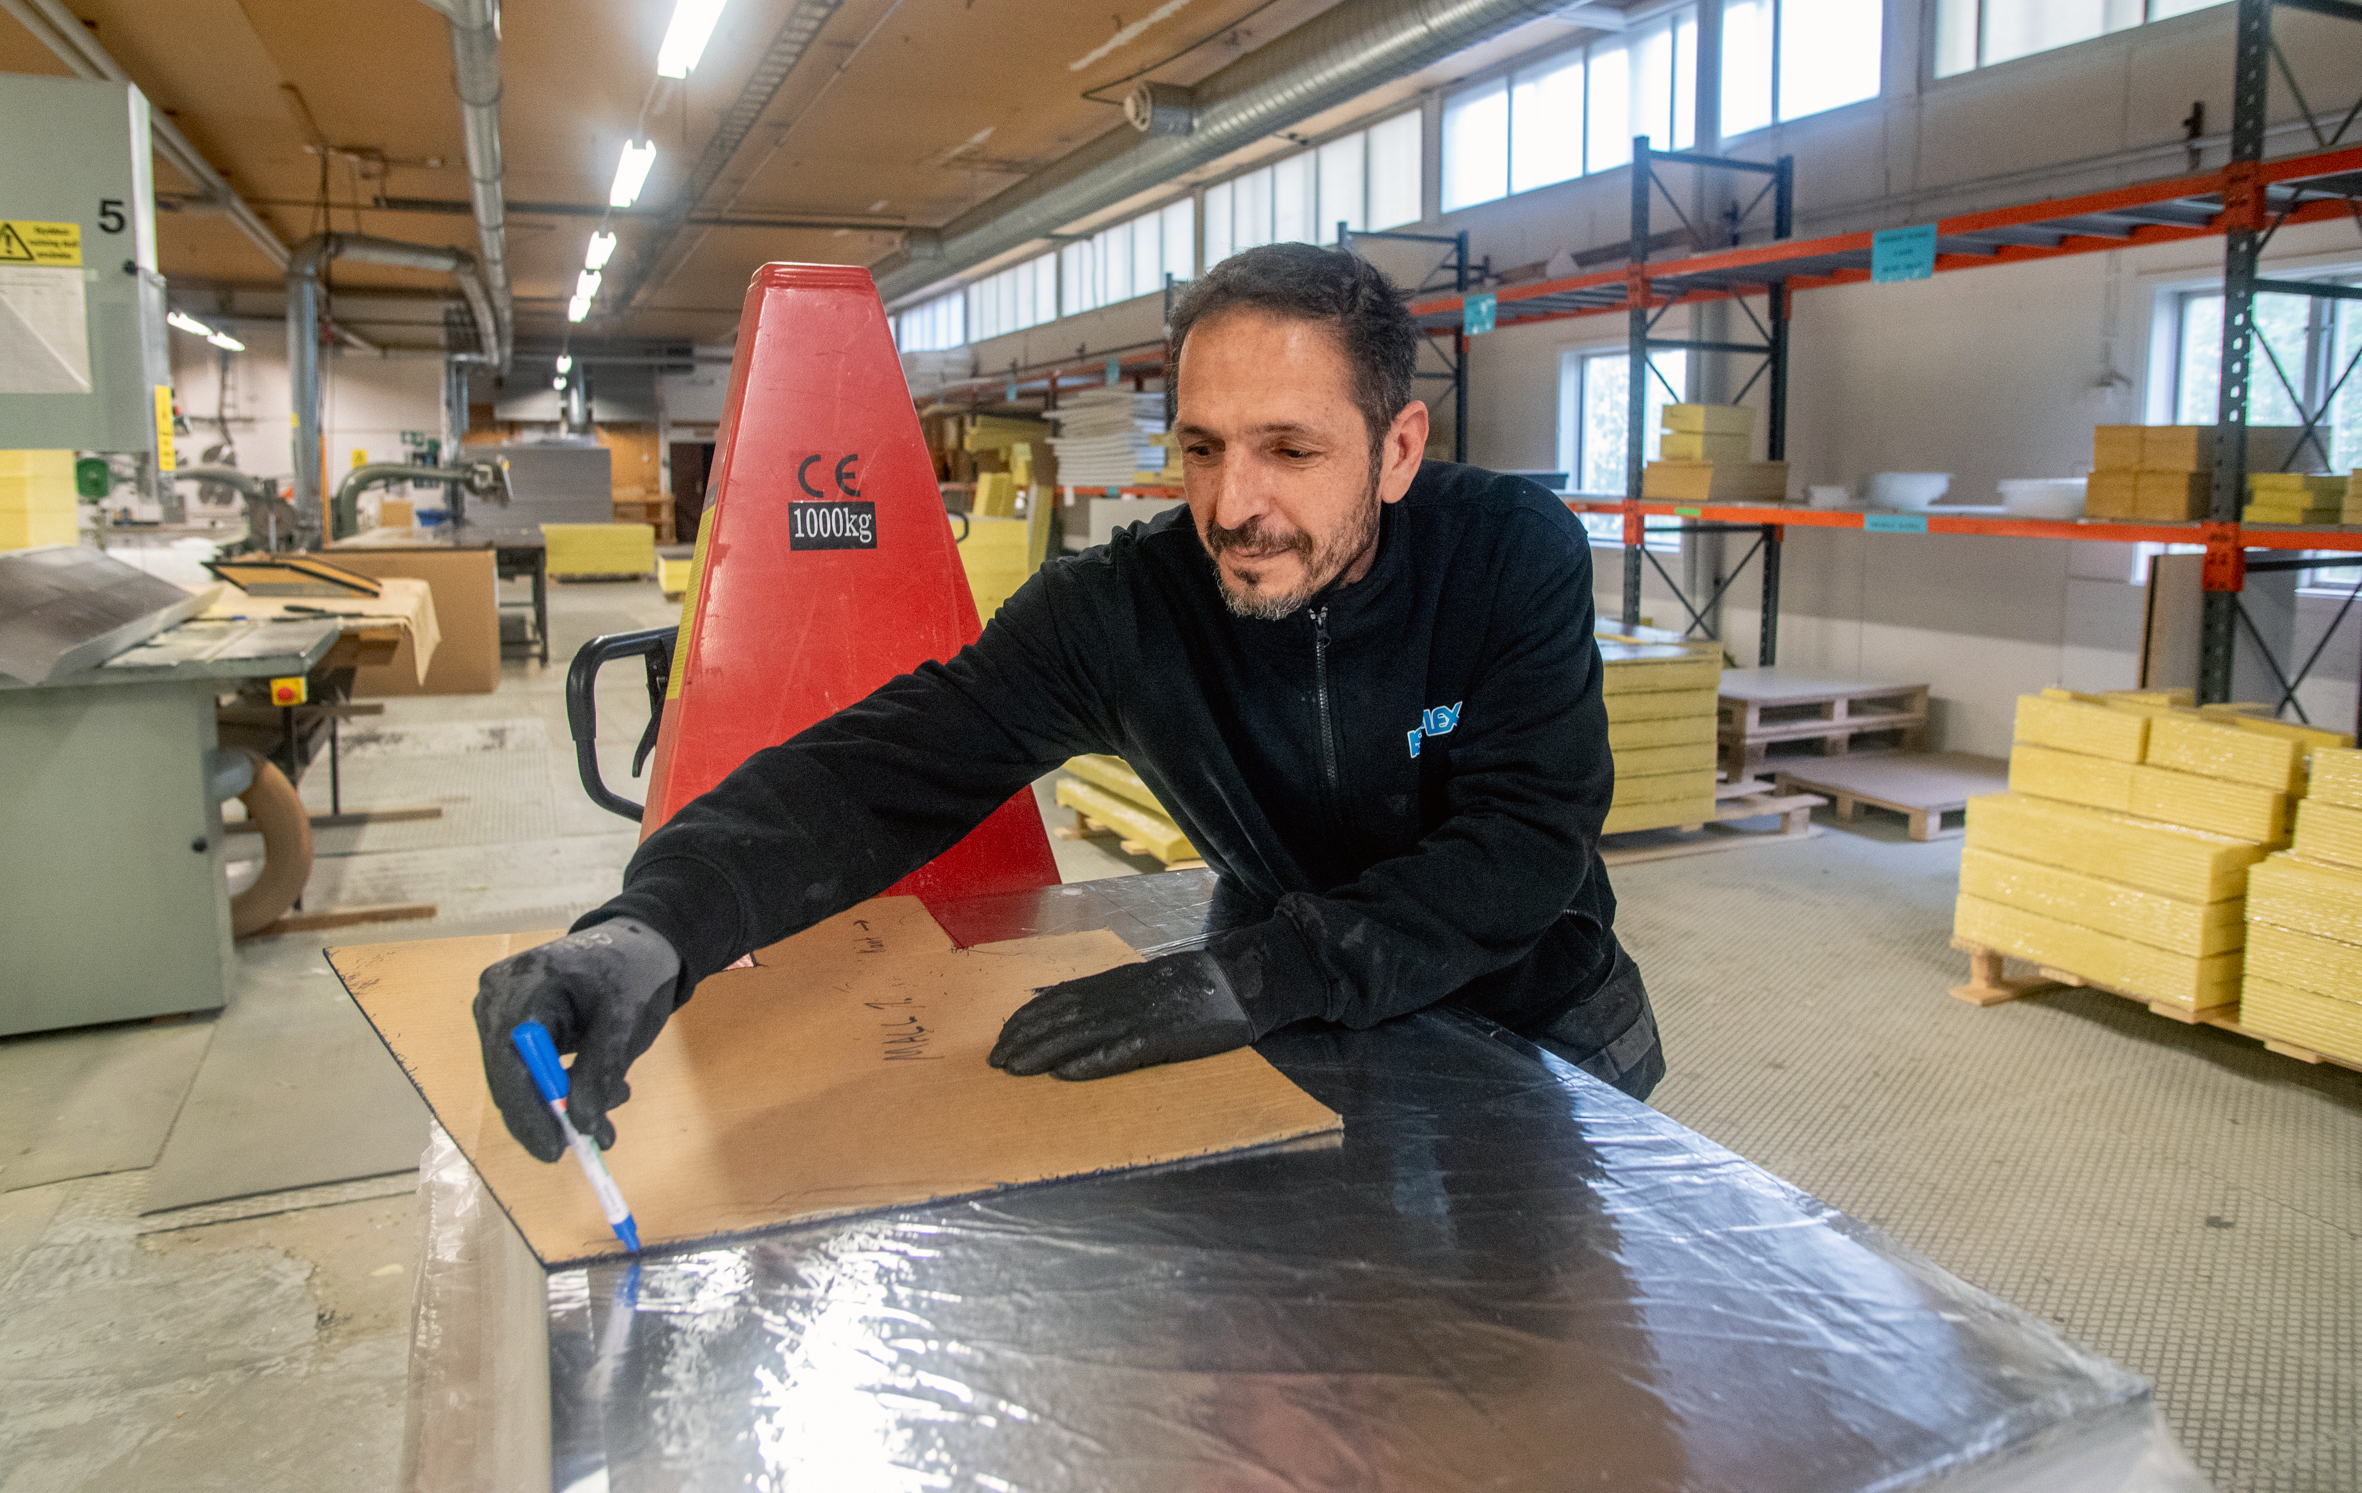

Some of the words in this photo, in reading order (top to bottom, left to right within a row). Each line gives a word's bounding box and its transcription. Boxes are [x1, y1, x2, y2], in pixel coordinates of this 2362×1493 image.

[99, 199, 126, 234] 5
[797, 453, 861, 498] CE
[793, 507, 872, 543] 1000kg
